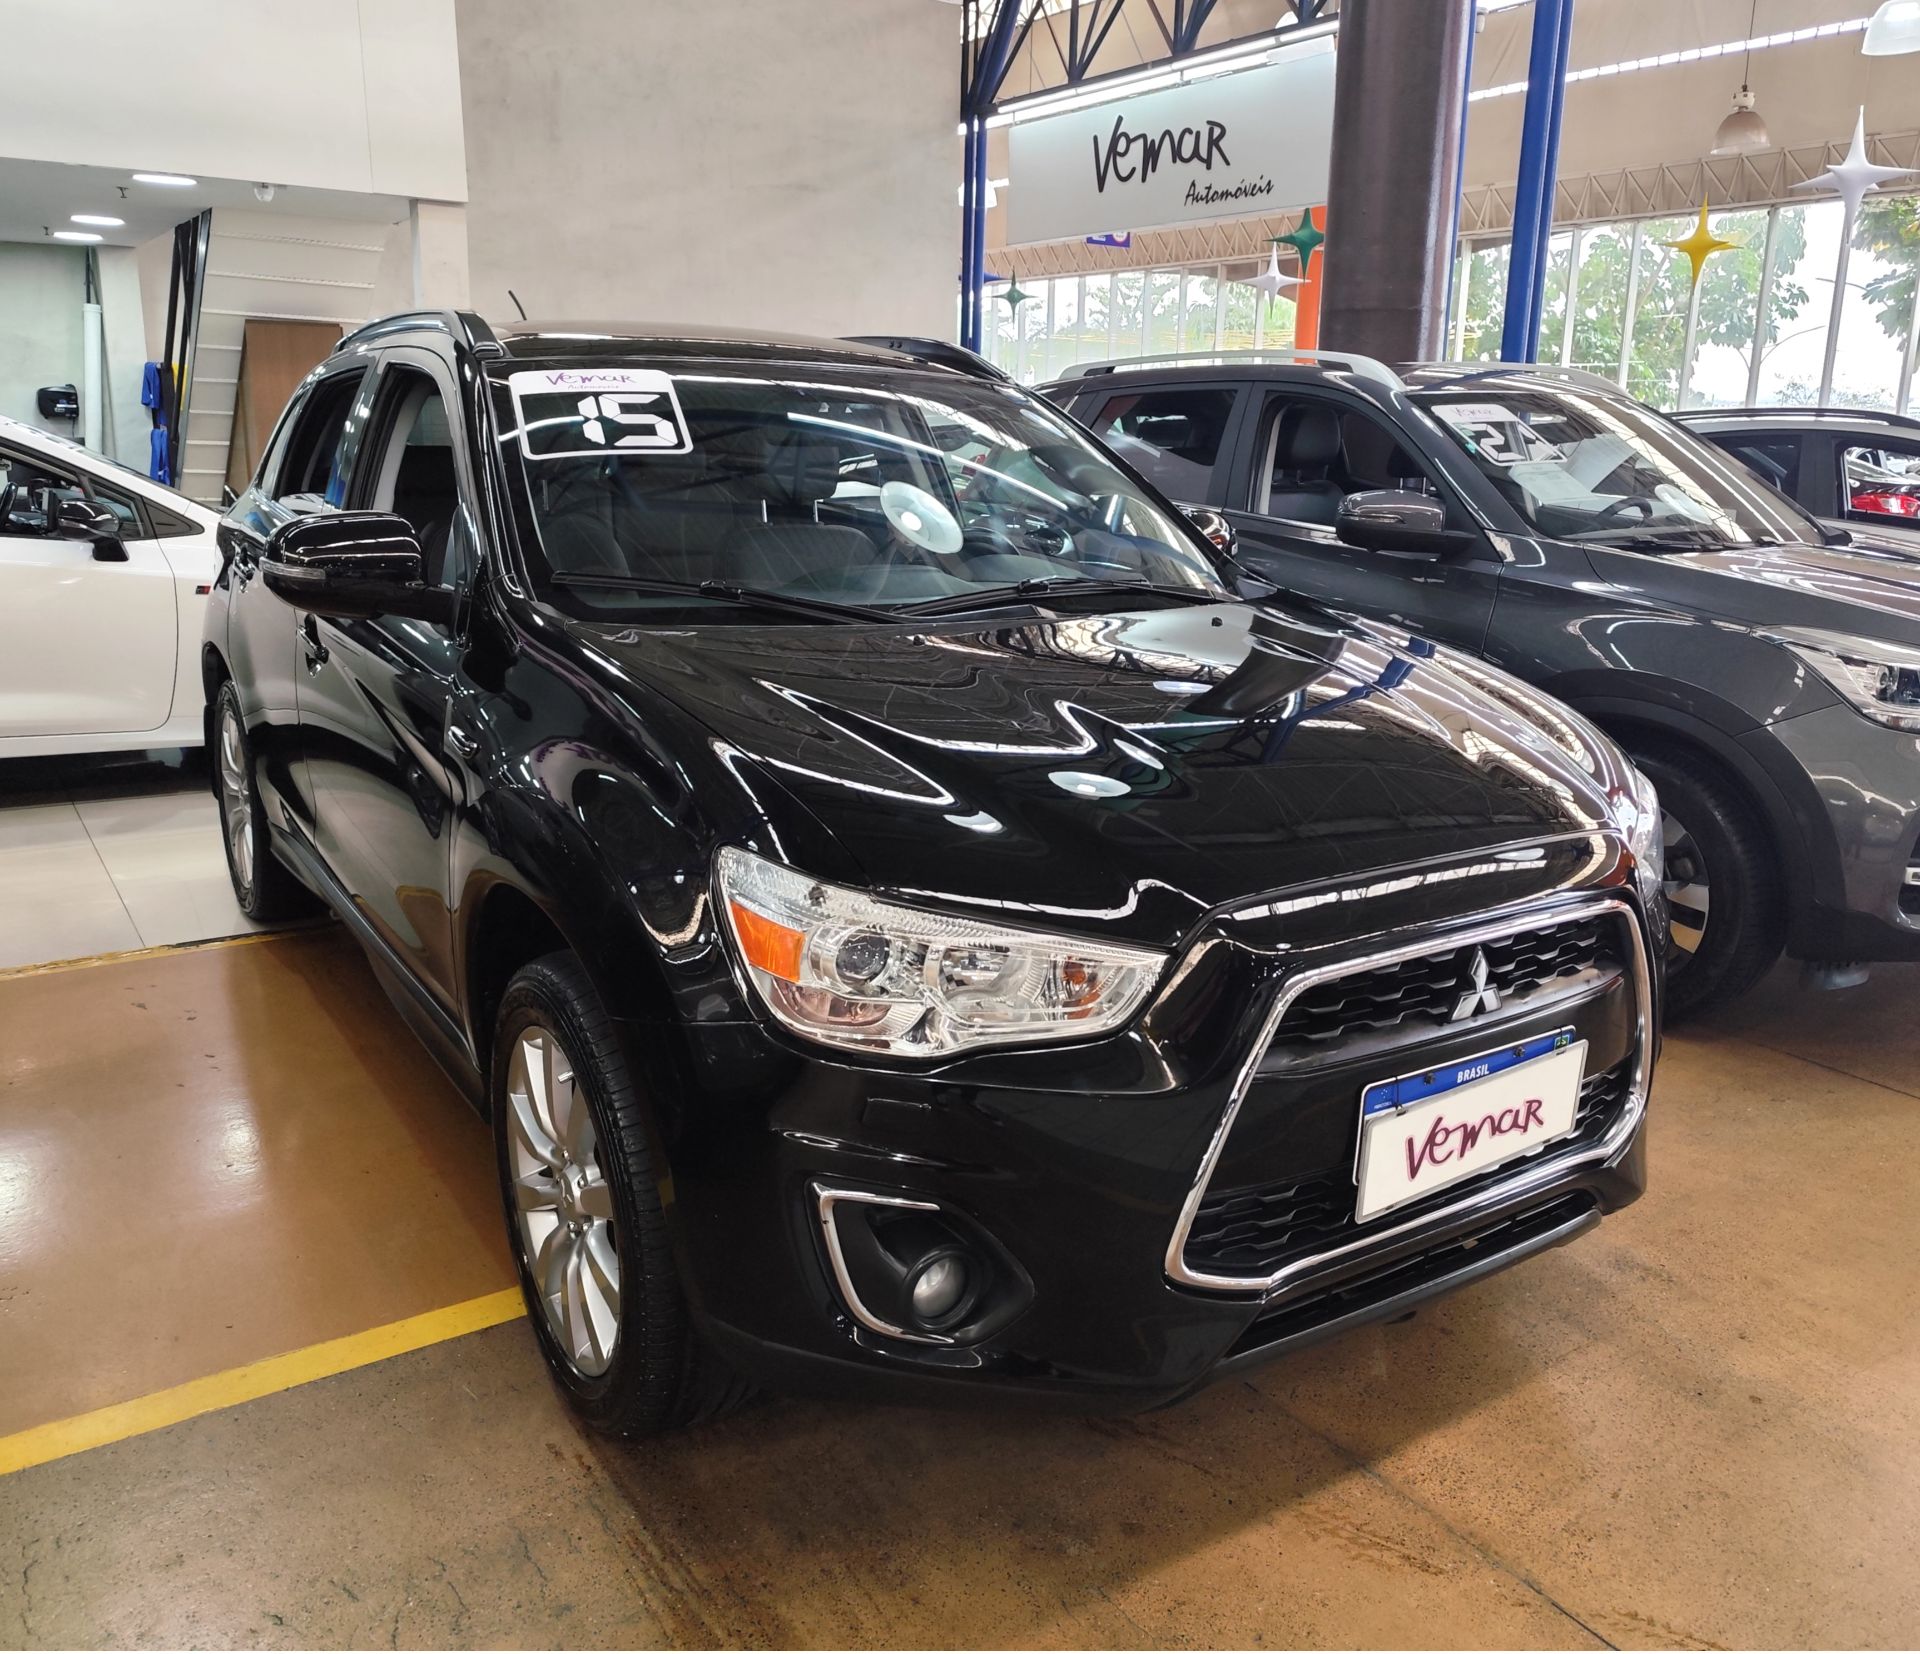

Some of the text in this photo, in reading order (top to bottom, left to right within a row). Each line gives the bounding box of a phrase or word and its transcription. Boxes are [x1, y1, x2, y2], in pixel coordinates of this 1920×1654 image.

[1184, 174, 1274, 206] Automóveis
[577, 393, 679, 447] 15
[1456, 1063, 1490, 1083] BRASIL
